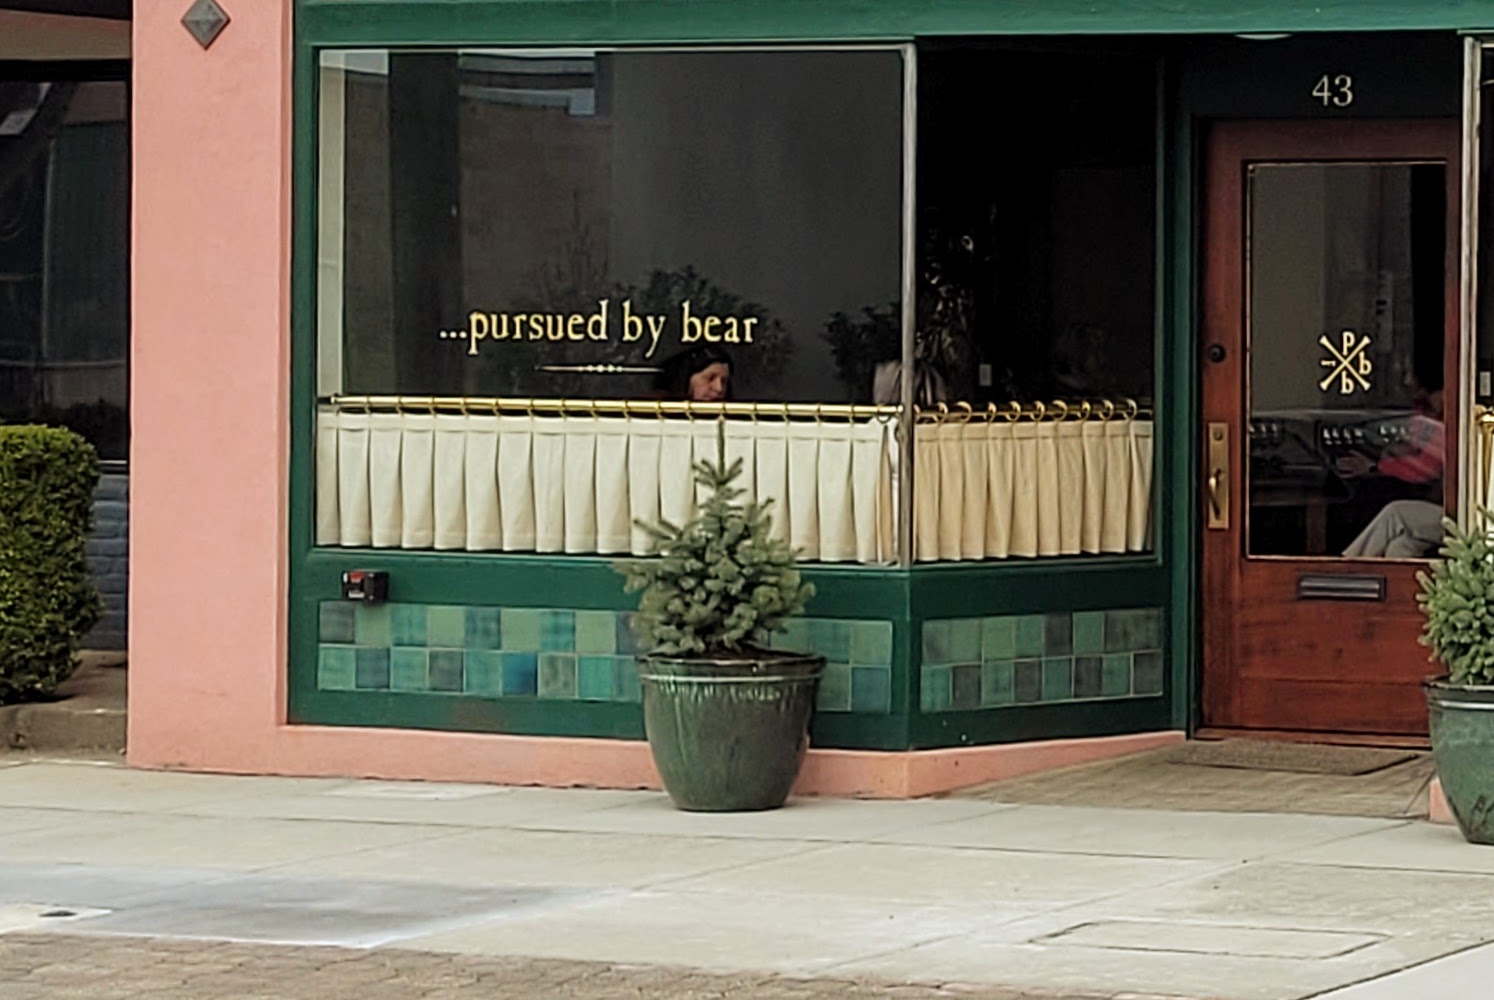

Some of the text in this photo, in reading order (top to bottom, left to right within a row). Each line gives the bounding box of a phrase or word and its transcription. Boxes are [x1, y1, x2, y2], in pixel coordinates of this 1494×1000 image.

[1312, 75, 1353, 107] 43
[439, 299, 758, 358] ...pursued by bear
